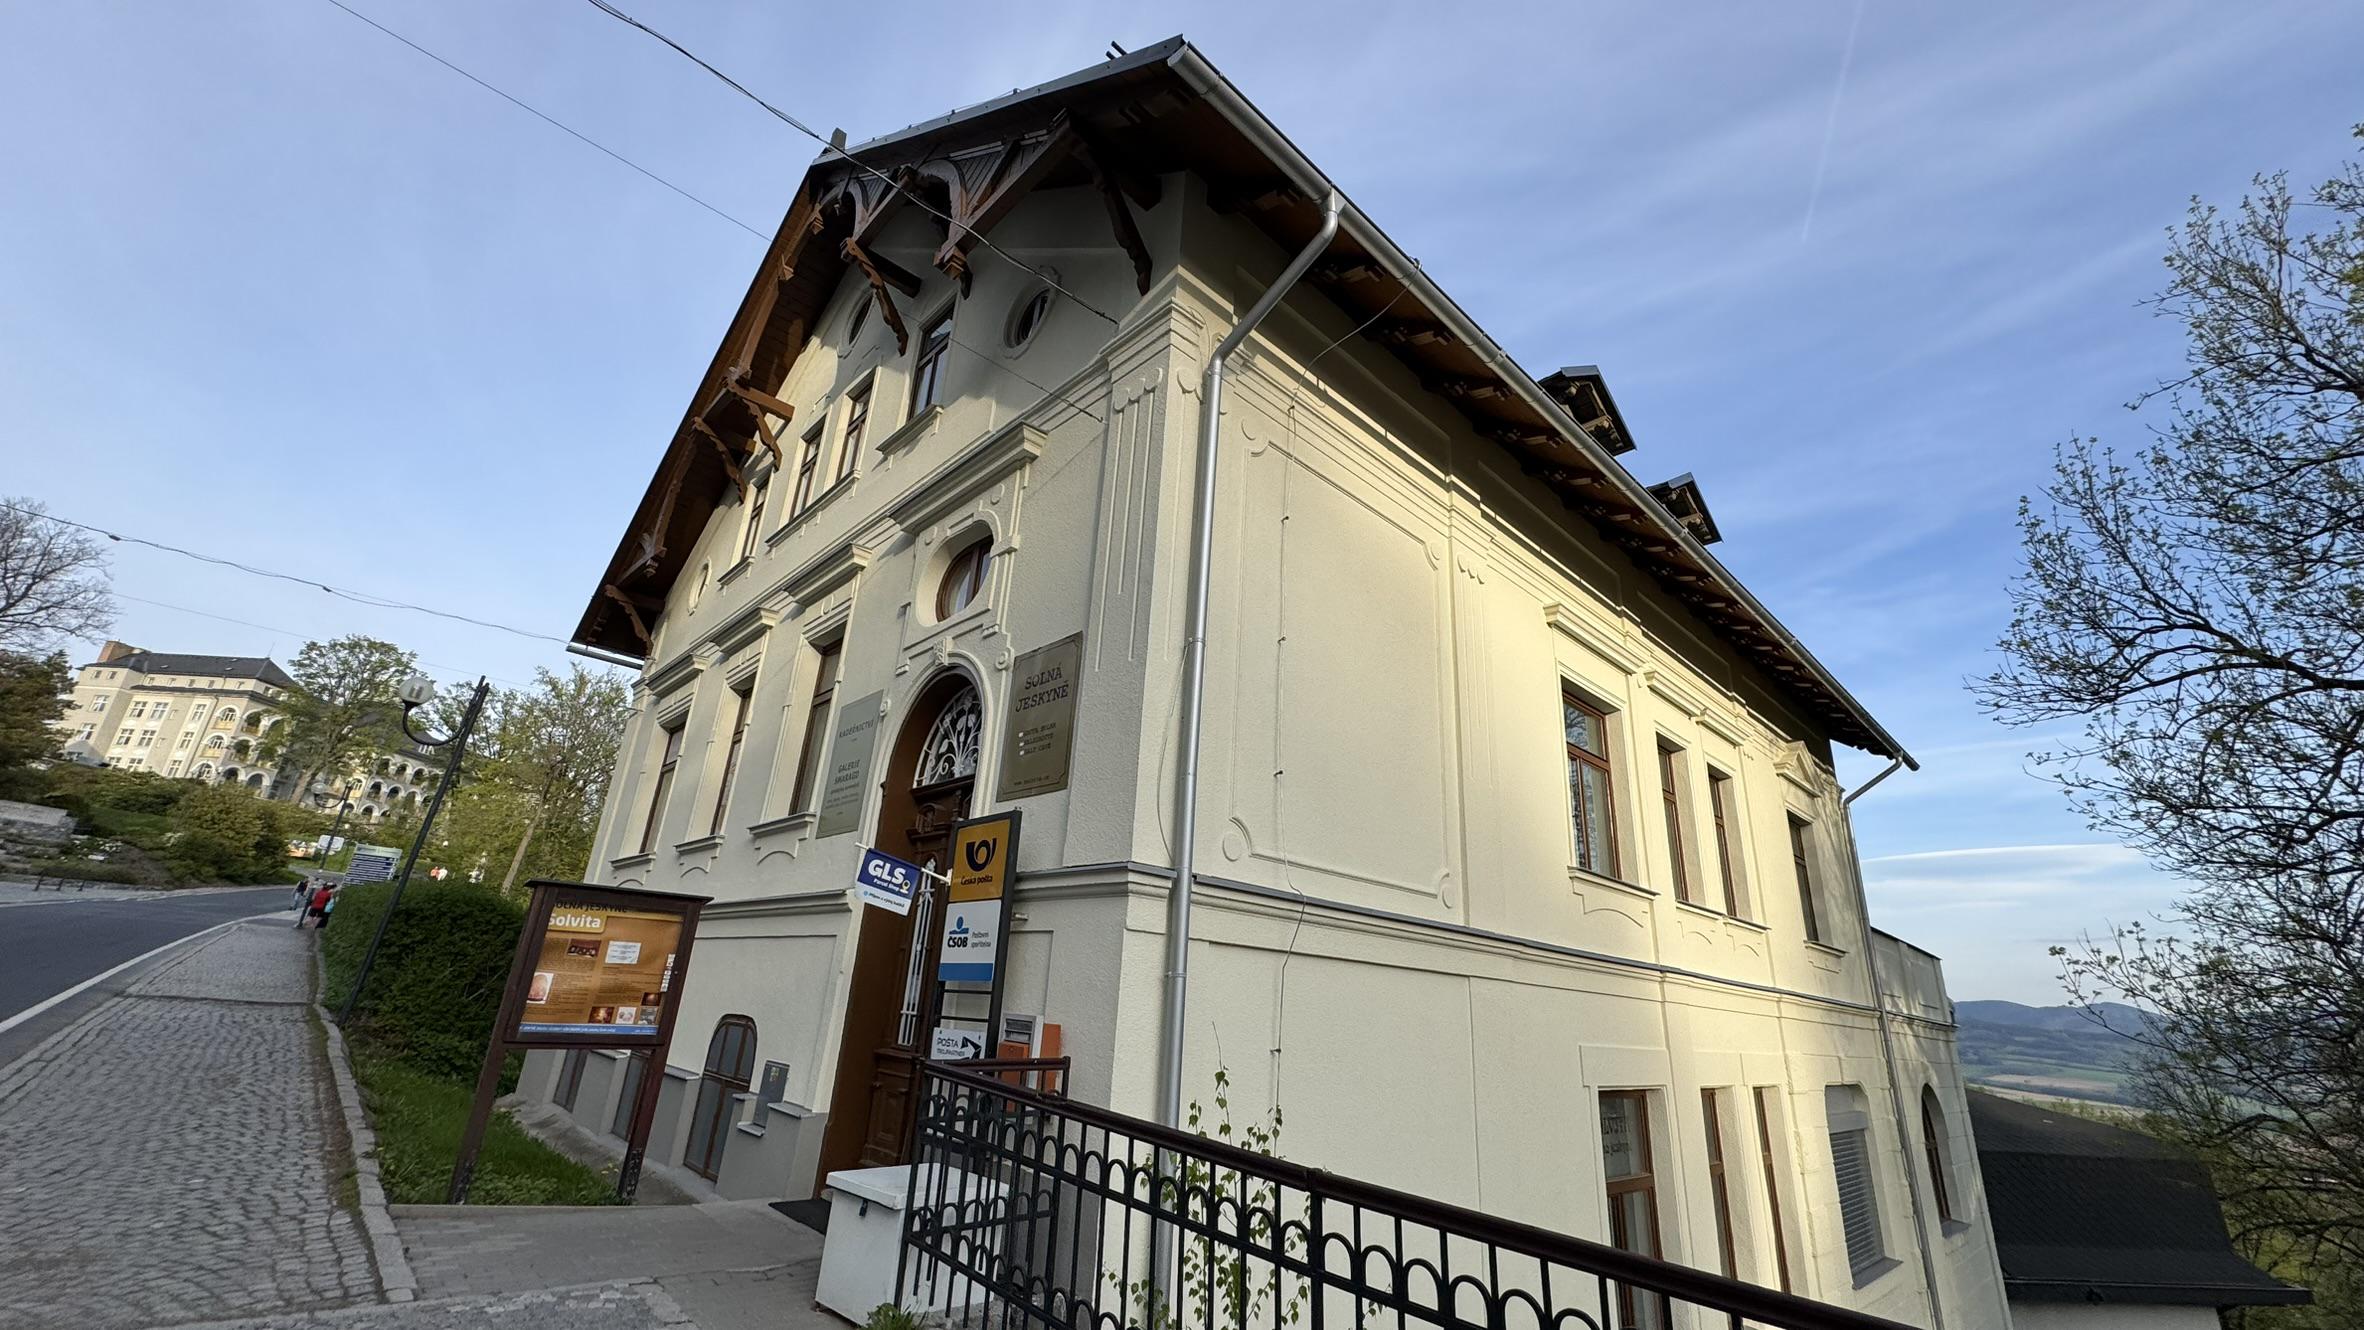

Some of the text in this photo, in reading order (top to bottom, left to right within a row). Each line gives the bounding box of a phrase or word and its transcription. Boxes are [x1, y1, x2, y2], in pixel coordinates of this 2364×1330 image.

[1025, 663, 1063, 690] SOLNÁ
[1015, 681, 1069, 712] JESKYNĚ
[868, 859, 906, 884] GLS
[961, 873, 993, 886] Česká pošta
[548, 911, 601, 928] Solvita
[947, 935, 968, 948] ČSOB
[937, 1036, 959, 1047] POŠTA
